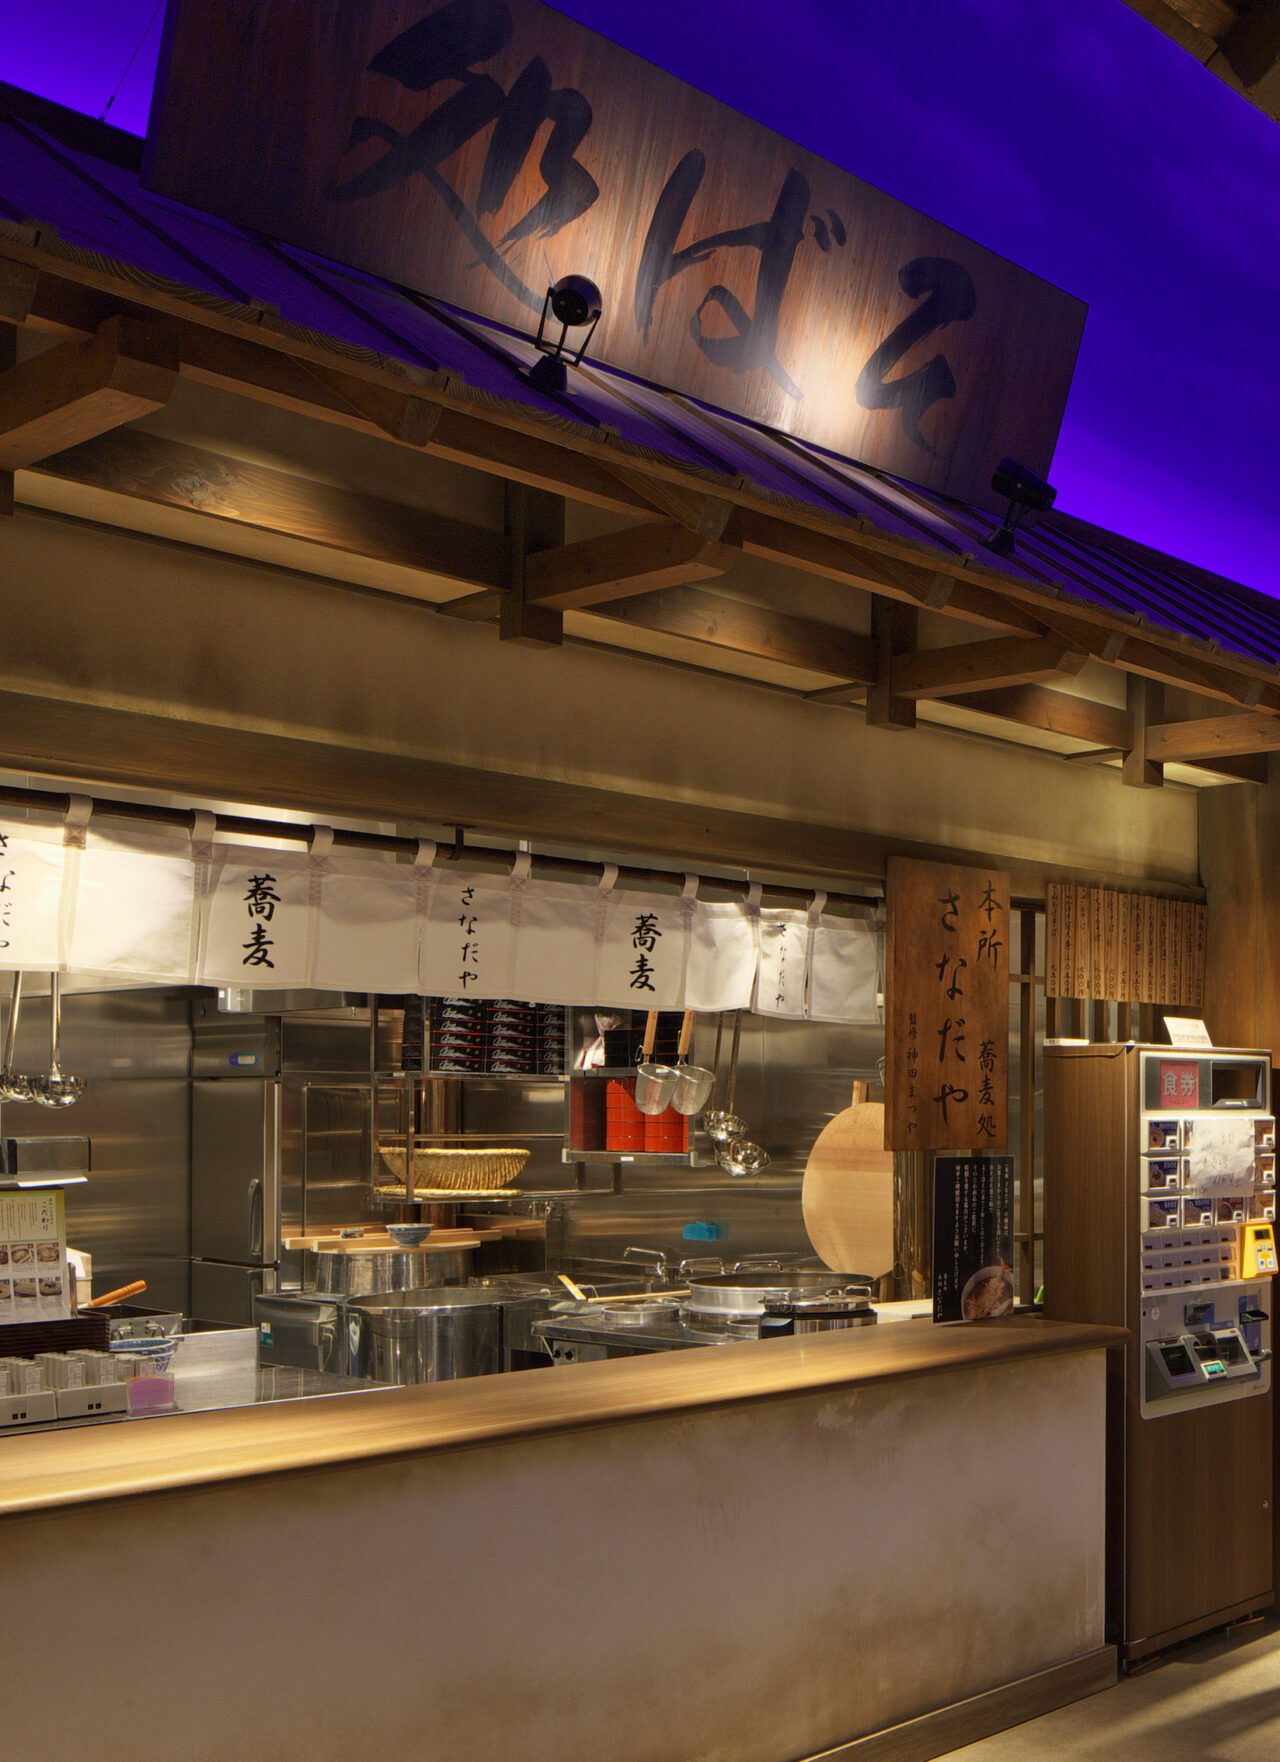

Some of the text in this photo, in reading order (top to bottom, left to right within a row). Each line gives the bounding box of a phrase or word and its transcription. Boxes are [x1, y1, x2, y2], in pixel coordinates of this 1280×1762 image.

[242, 874, 282, 969] 蕎麦
[458, 885, 479, 990] さなだや
[629, 913, 662, 993] 蕎麦
[933, 888, 969, 1126] さなだや
[976, 879, 1003, 1138] 本所 蕎麦処
[906, 1046, 919, 1134] 神田まつや
[1162, 1069, 1195, 1098] 食券
